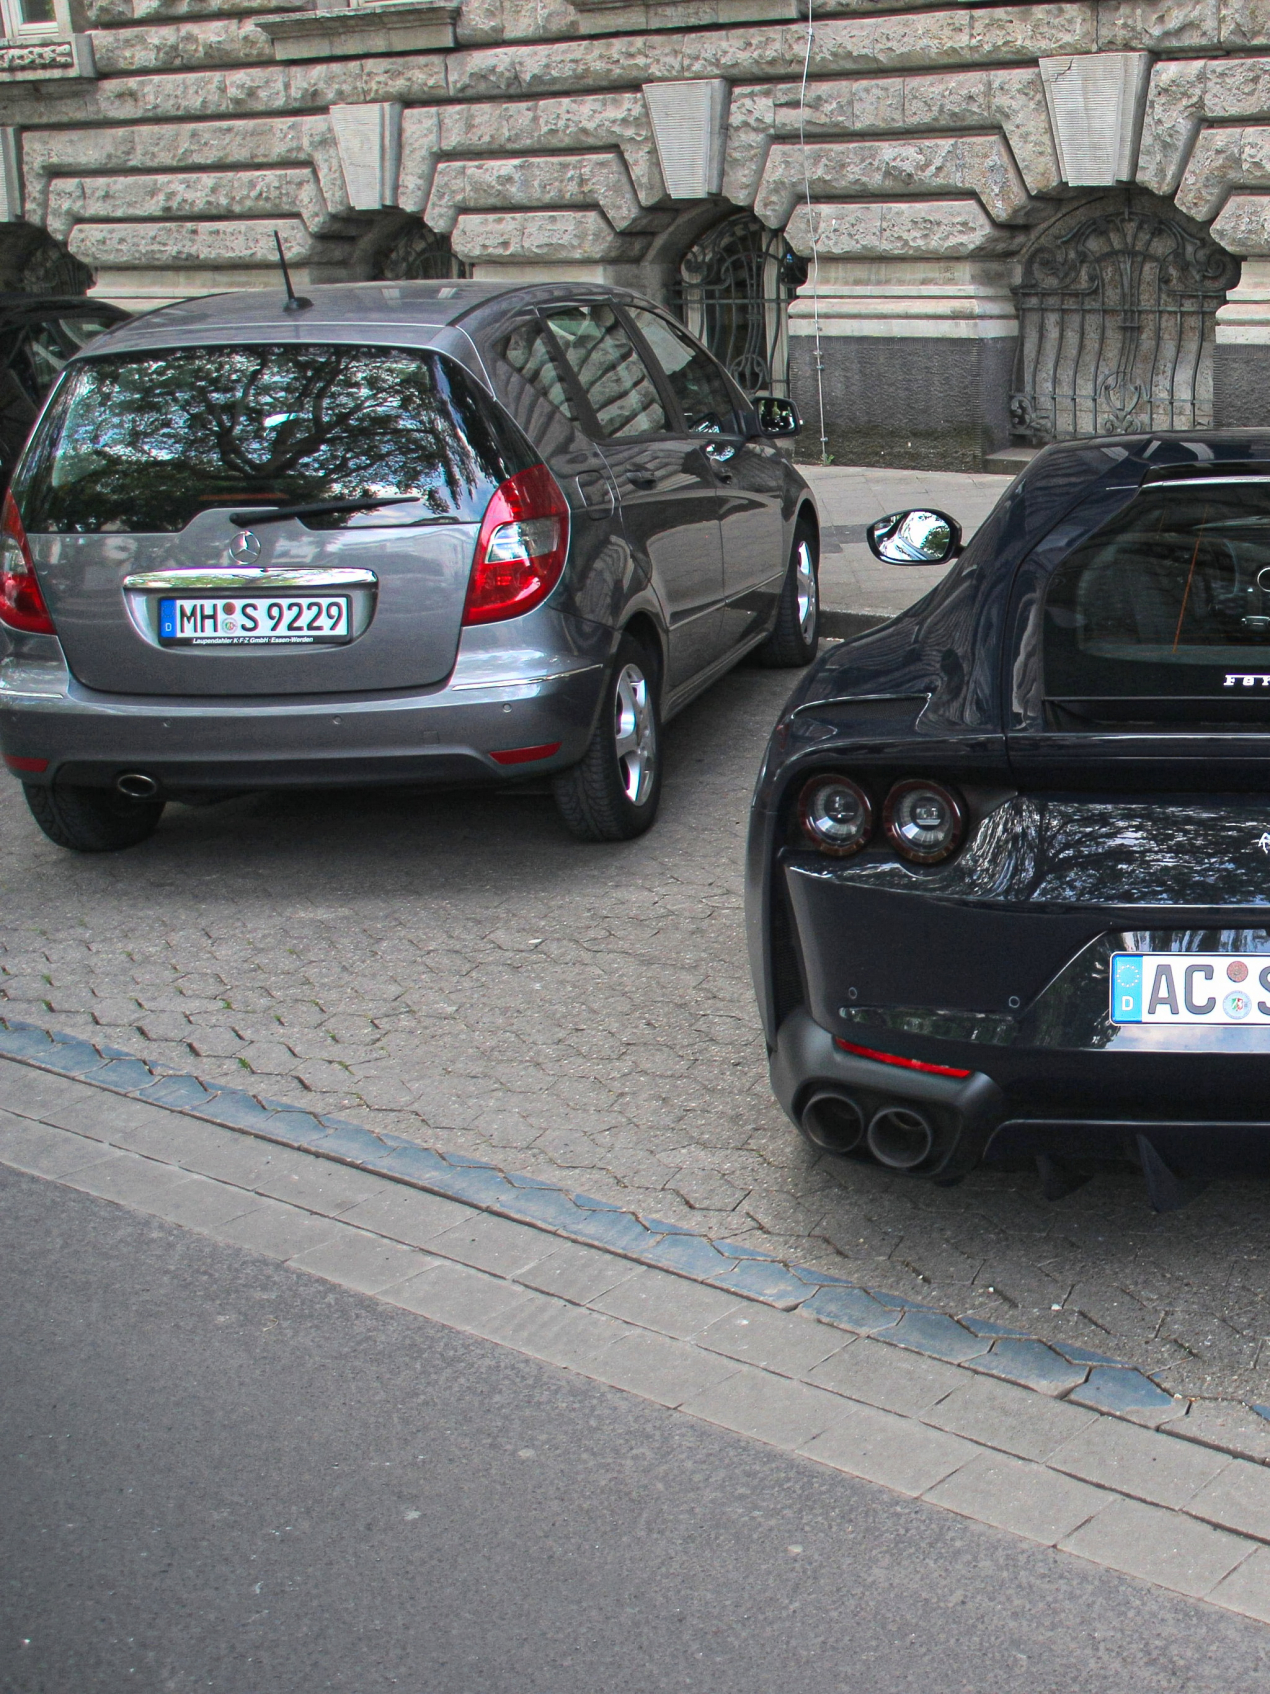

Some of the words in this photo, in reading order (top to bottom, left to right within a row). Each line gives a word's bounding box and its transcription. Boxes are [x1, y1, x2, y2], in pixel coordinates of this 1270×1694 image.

[165, 623, 172, 632] D
[179, 603, 218, 633] MH
[241, 602, 259, 632] S
[267, 601, 344, 632] 9229
[1147, 964, 1216, 1015] AC
[1121, 997, 1133, 1011] D
